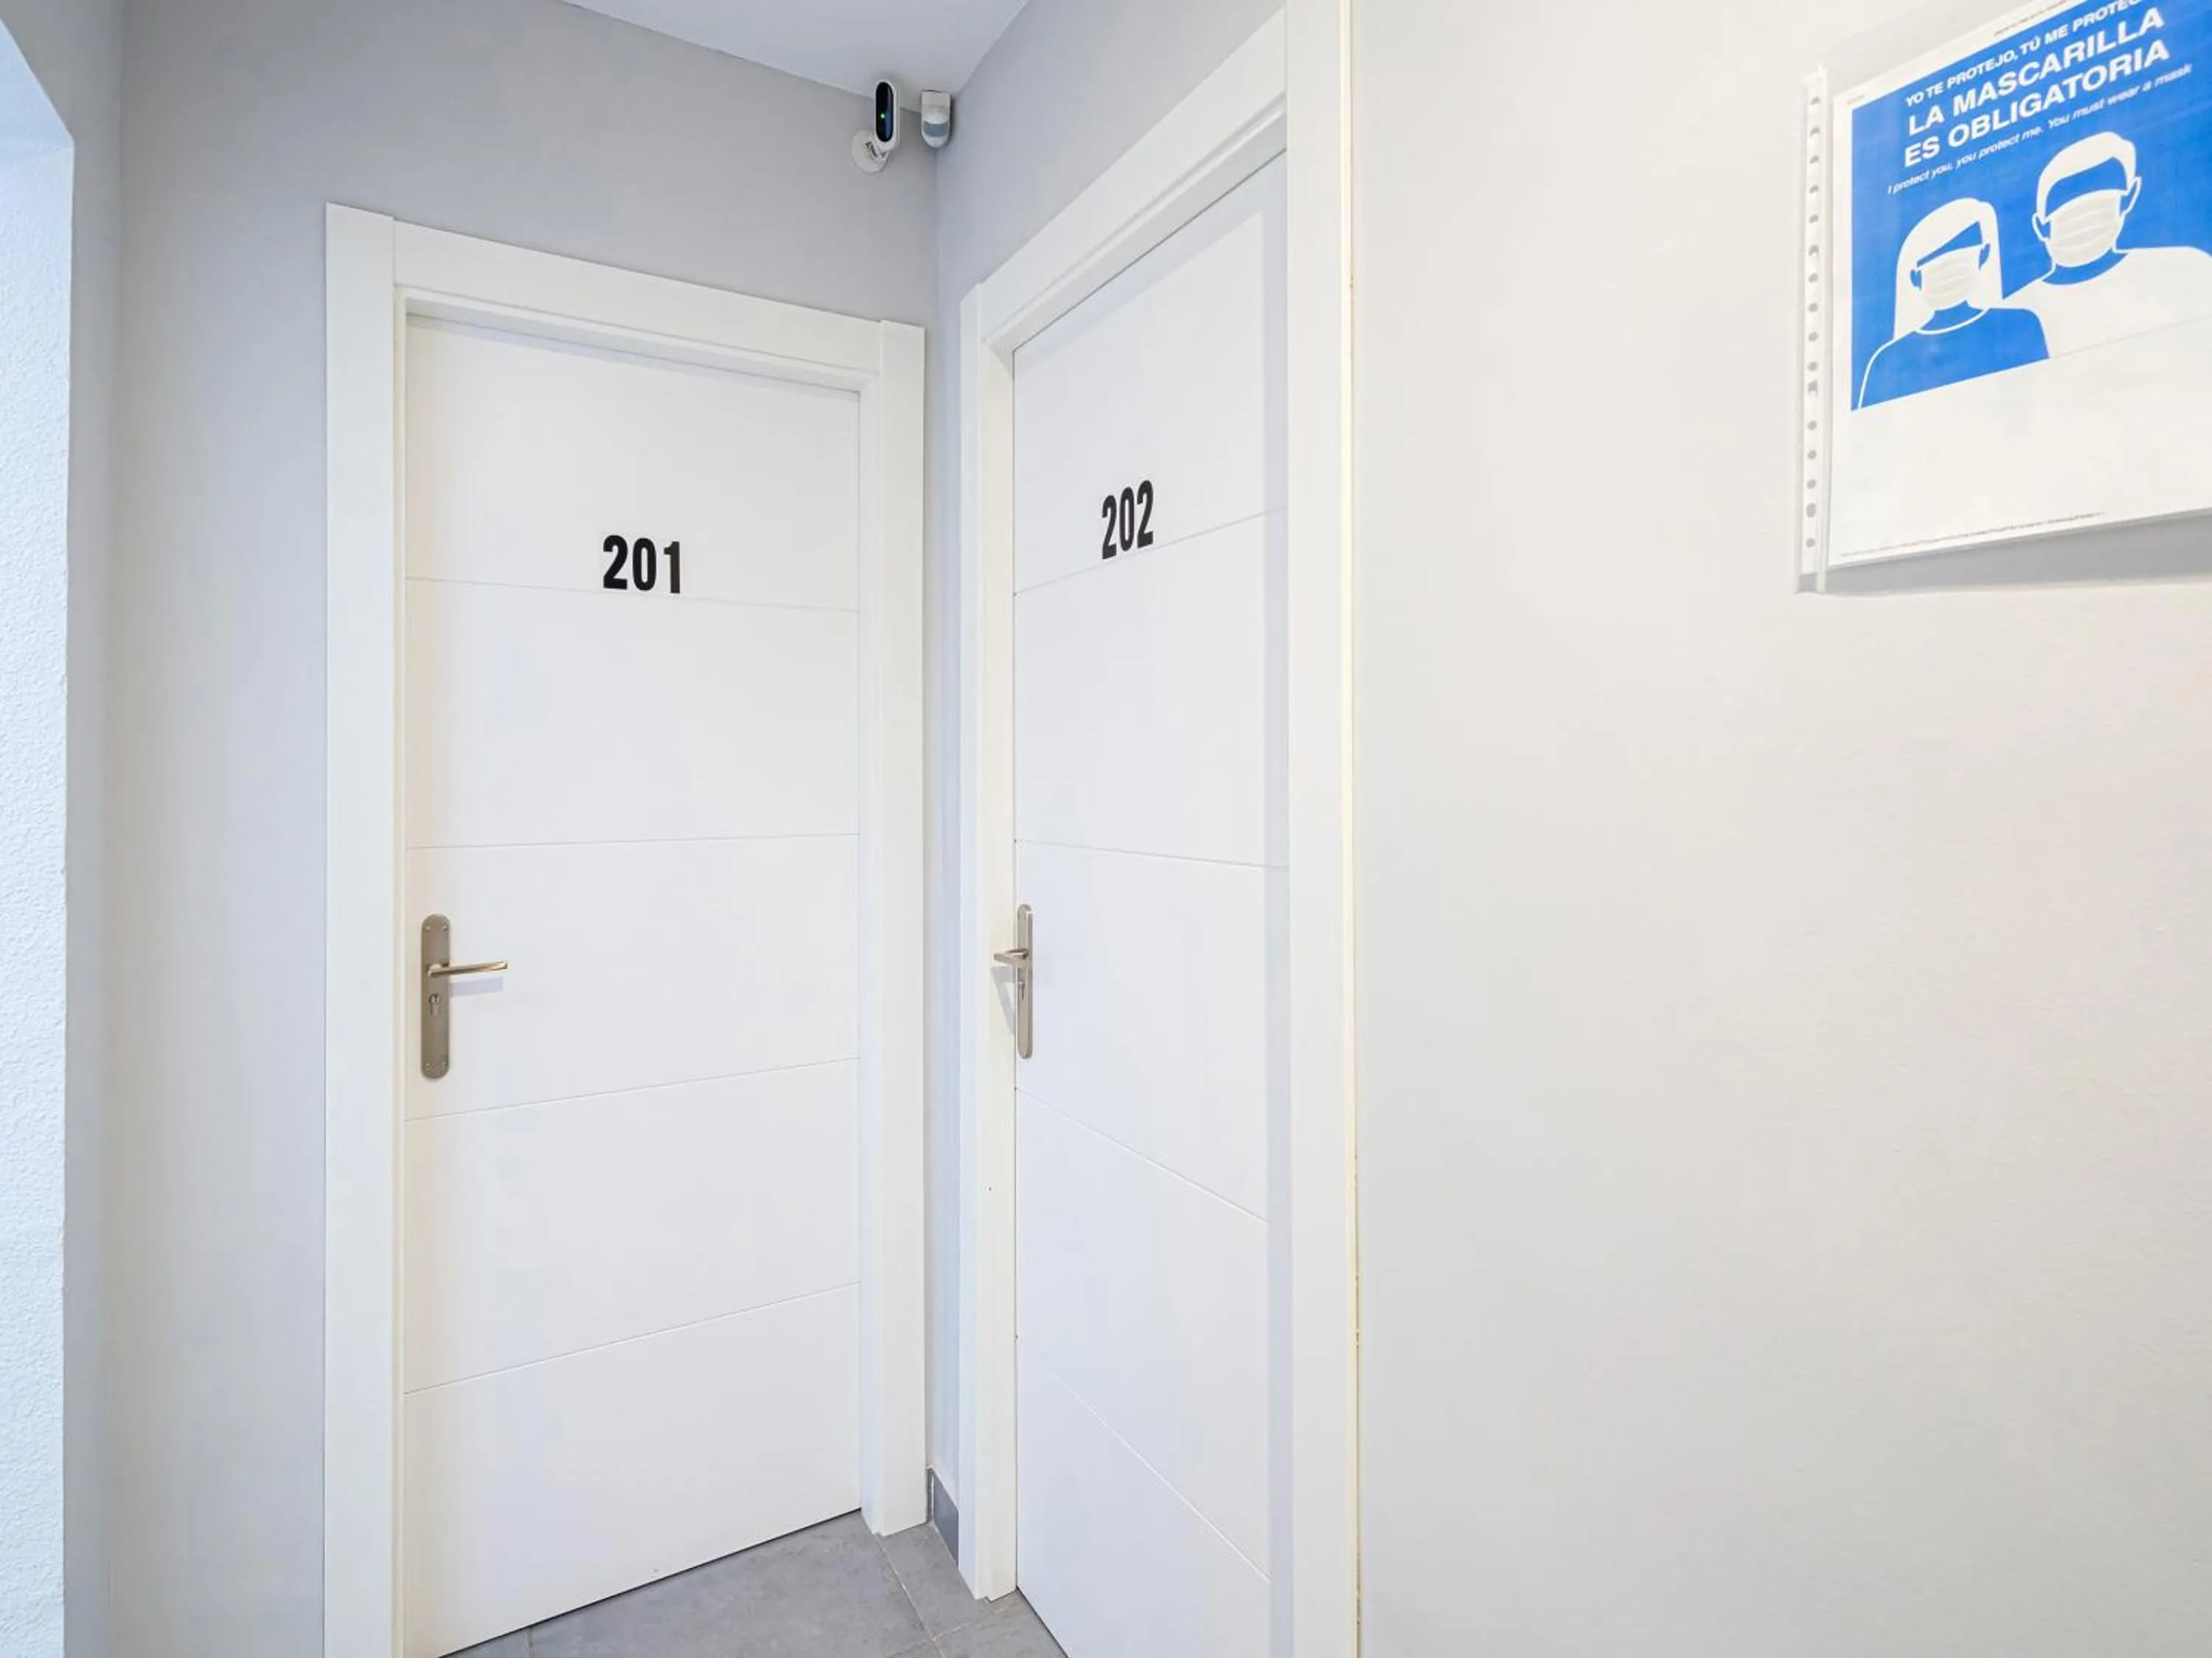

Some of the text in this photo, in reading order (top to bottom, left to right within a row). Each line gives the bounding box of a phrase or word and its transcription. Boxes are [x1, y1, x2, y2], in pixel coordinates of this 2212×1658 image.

[1905, 38, 2170, 168] ES OBLIGATORIA
[1906, 91, 1924, 107] YO
[1925, 82, 1944, 98] TE
[1947, 50, 2018, 89] PROTEJO,
[2045, 24, 2069, 44] ME
[1908, 104, 1945, 136] LA
[1953, 7, 2165, 117] MASCARILLA
[1892, 170, 1930, 195] protect
[1955, 153, 1978, 170] you
[1978, 133, 2020, 160] protect
[2048, 114, 2070, 129] You
[2071, 98, 2105, 120] must
[2107, 86, 2141, 106] wear
[2141, 80, 2152, 93] a
[2154, 63, 2193, 88] mask
[602, 533, 681, 594] 201
[1100, 479, 1155, 561] 202
